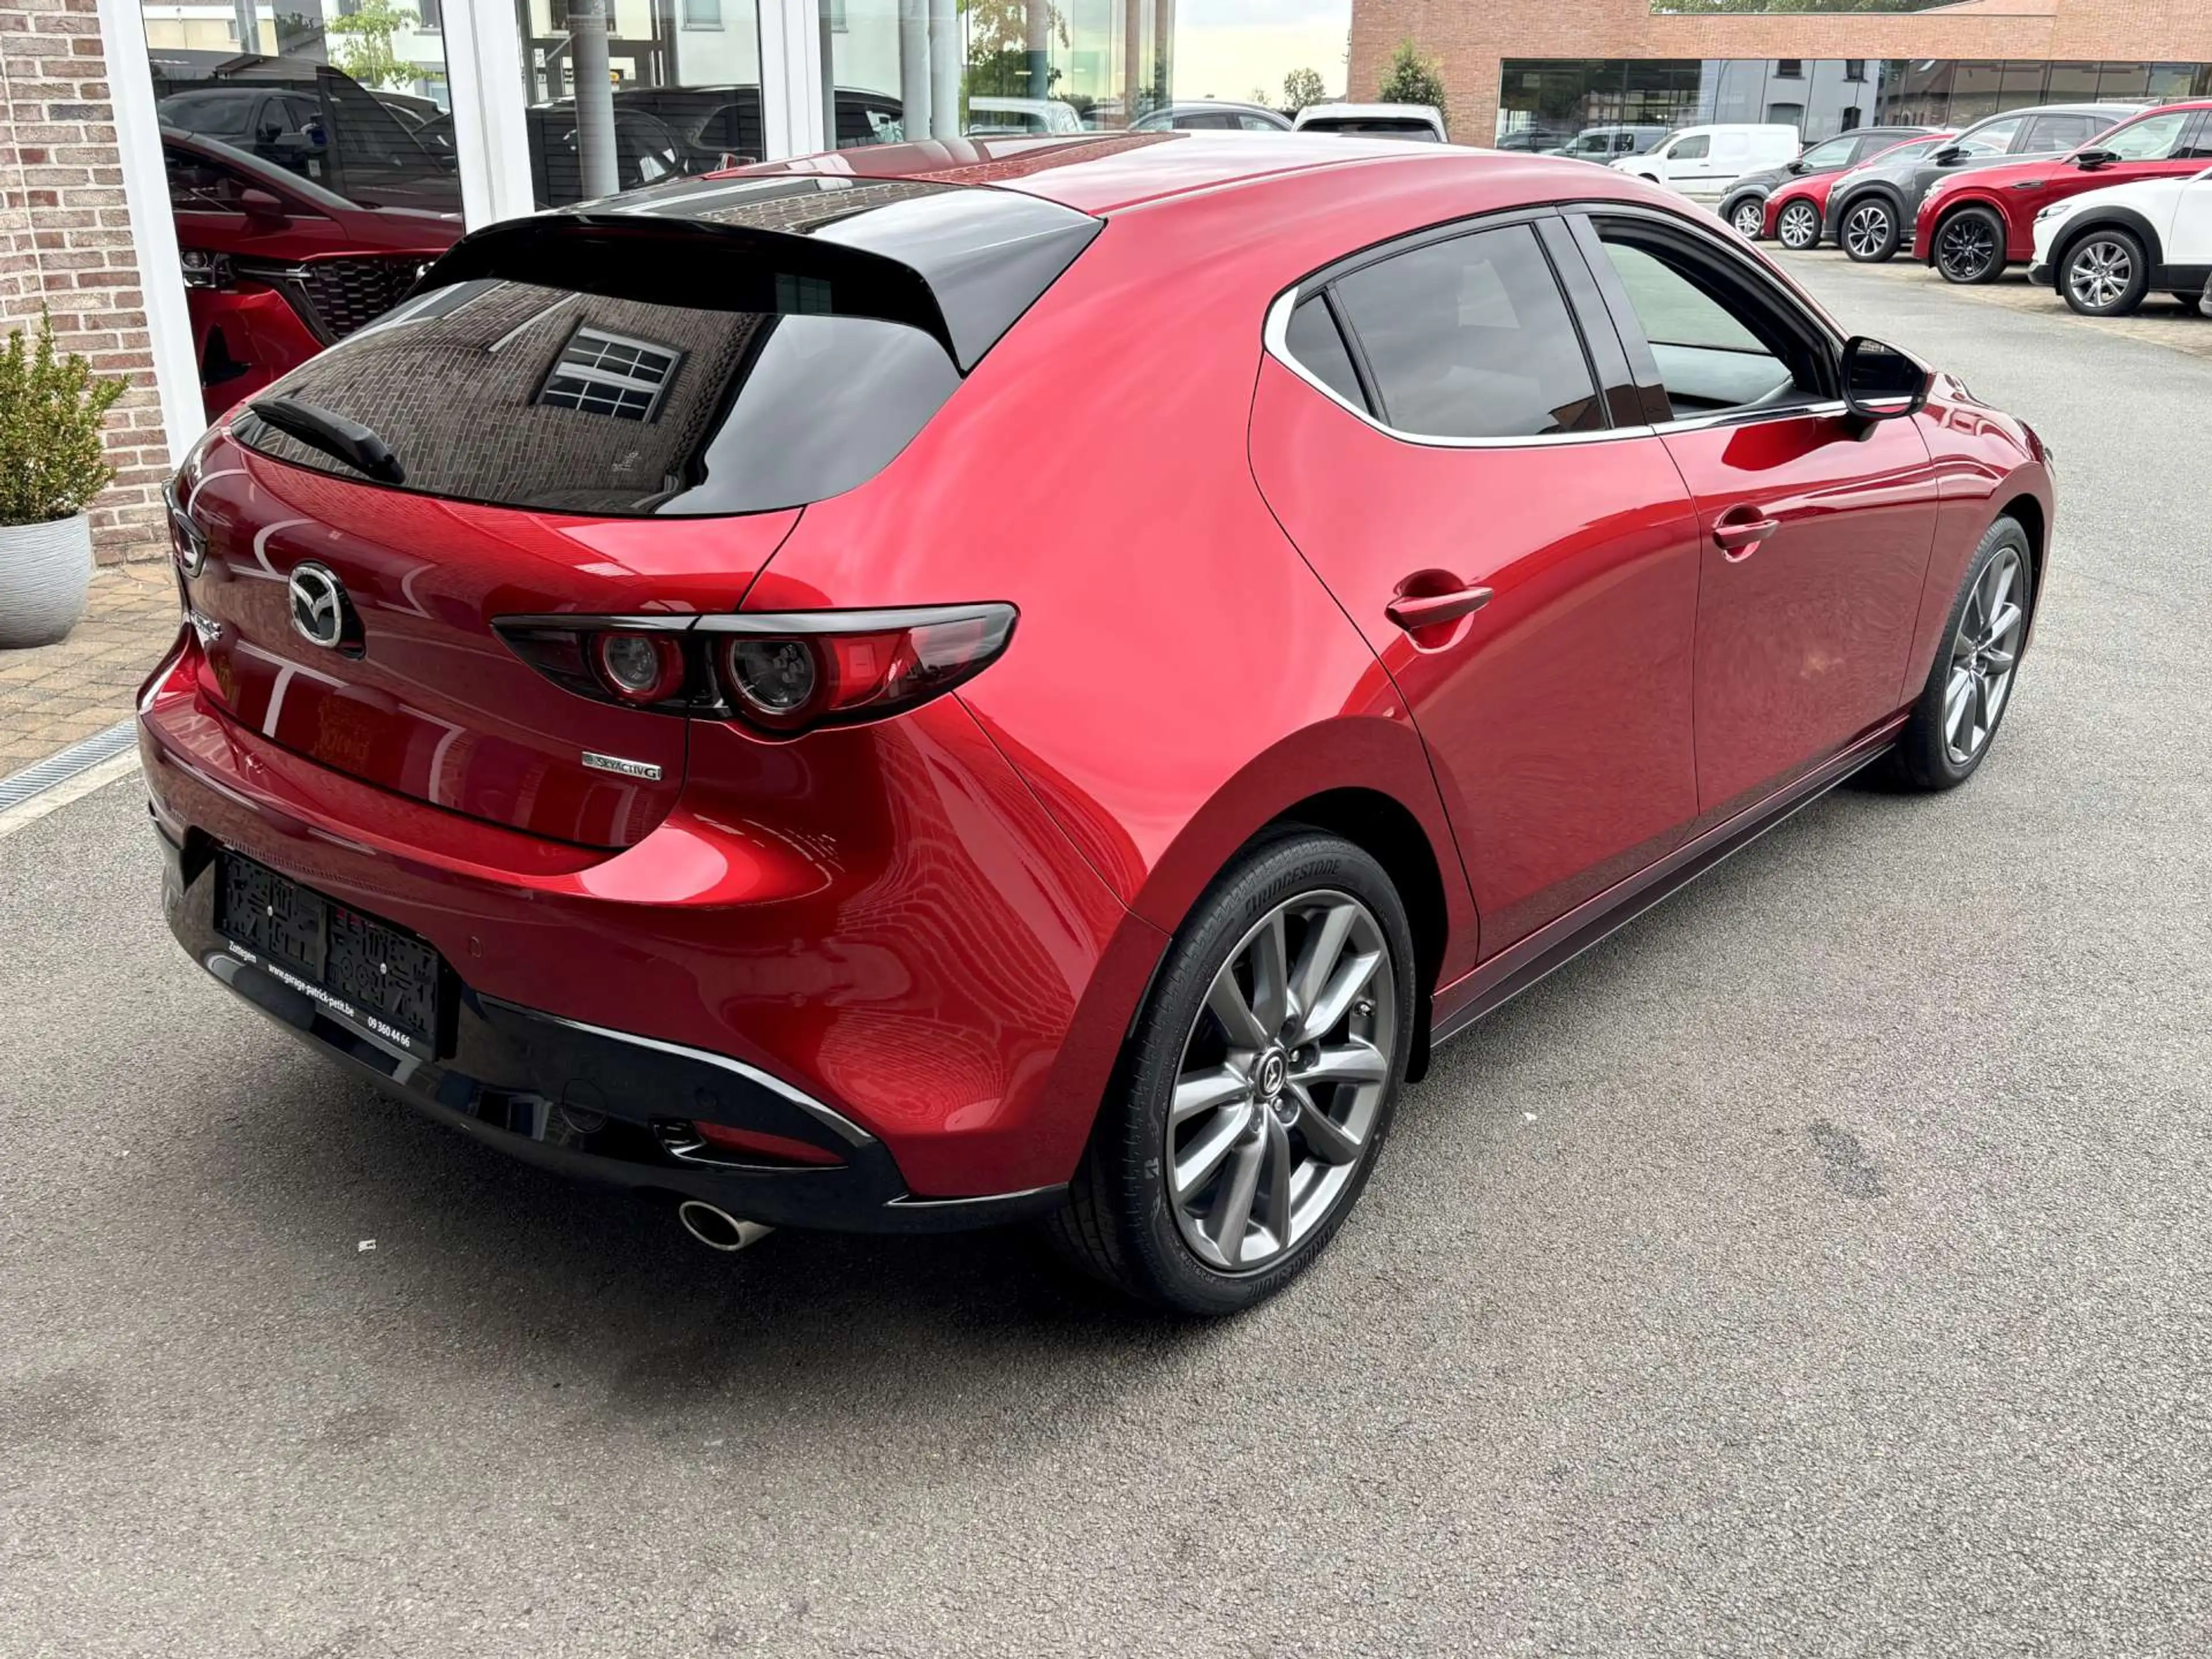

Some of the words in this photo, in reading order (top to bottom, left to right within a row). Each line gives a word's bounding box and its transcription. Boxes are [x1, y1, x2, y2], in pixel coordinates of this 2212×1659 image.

[1245, 859, 1340, 918] BRIDGESTONE
[229, 940, 257, 964] Zottegem
[268, 963, 355, 1017] www.garage-patrick-petit.be
[368, 1016, 377, 1029] 09
[377, 1021, 391, 1037] 360
[391, 1029, 400, 1042] 44
[400, 1034, 410, 1048] 66
